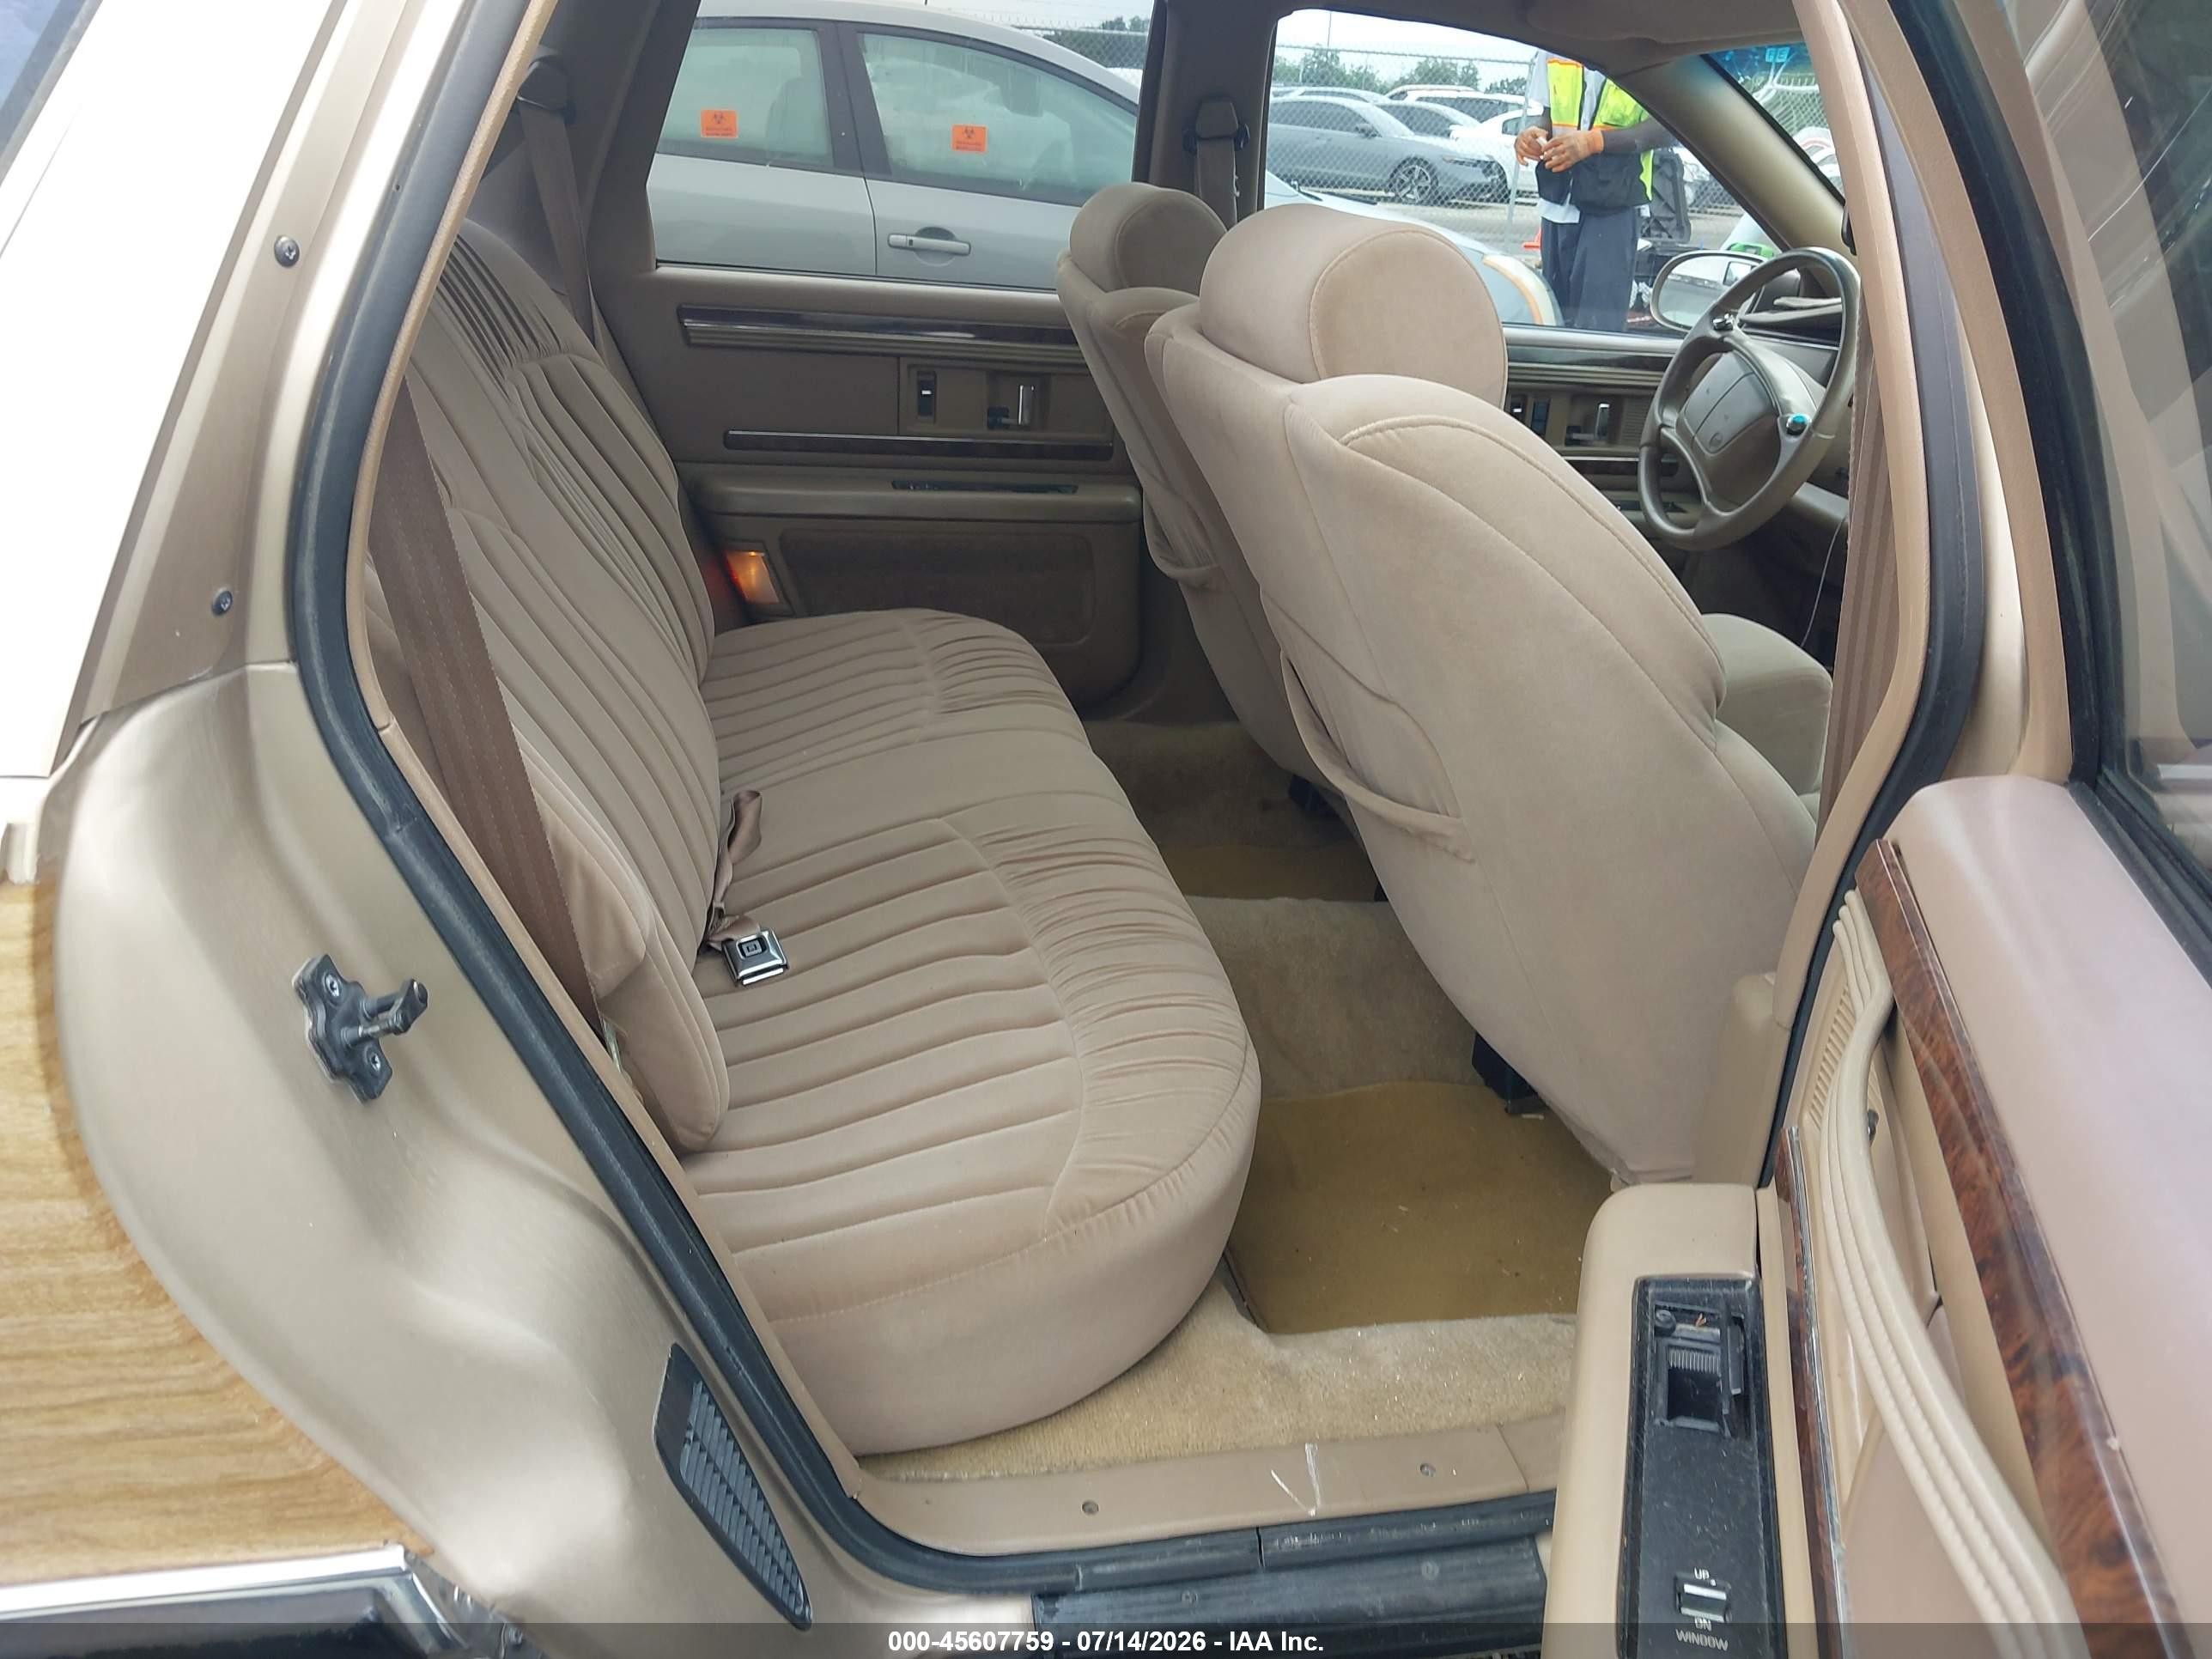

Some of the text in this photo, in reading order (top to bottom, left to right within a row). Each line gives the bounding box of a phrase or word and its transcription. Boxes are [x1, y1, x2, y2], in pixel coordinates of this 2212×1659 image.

[1694, 1567, 1710, 1580] UP
[1694, 1617, 1712, 1631] DN
[1675, 1629, 1729, 1651] WINDOW
